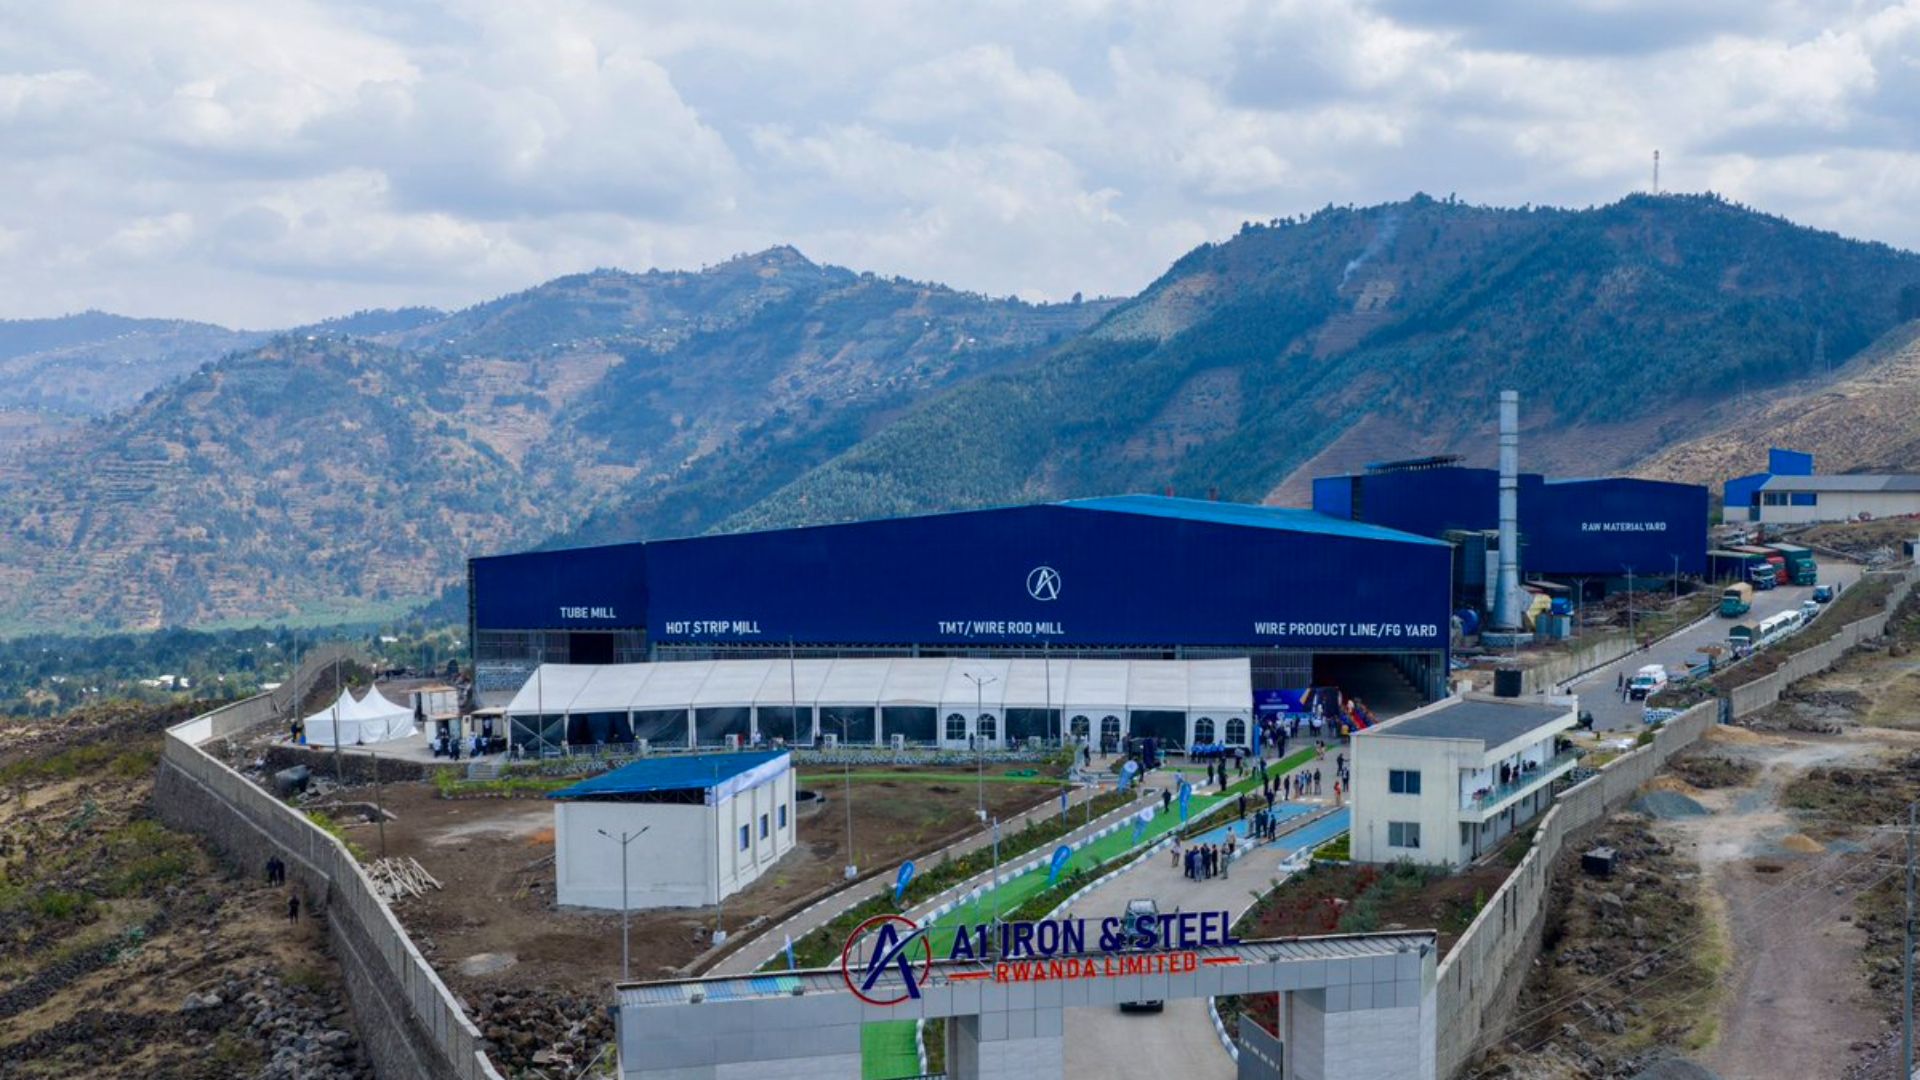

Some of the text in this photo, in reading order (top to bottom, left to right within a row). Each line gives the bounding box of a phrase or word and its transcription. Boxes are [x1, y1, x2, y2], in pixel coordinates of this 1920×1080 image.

[1582, 522, 1601, 531] RAW
[560, 607, 617, 618] TUBE MILL
[666, 621, 761, 634] HOT STRIP MILL
[1008, 621, 1032, 634] ROD
[1036, 622, 1065, 634] MILL
[1255, 622, 1286, 635] WIRE
[1289, 623, 1347, 636] PRODUCT
[1405, 624, 1437, 637] YARD
[950, 910, 1240, 960] A1 IRON & STEEL
[996, 951, 1197, 983] RWANDA LIMITED
